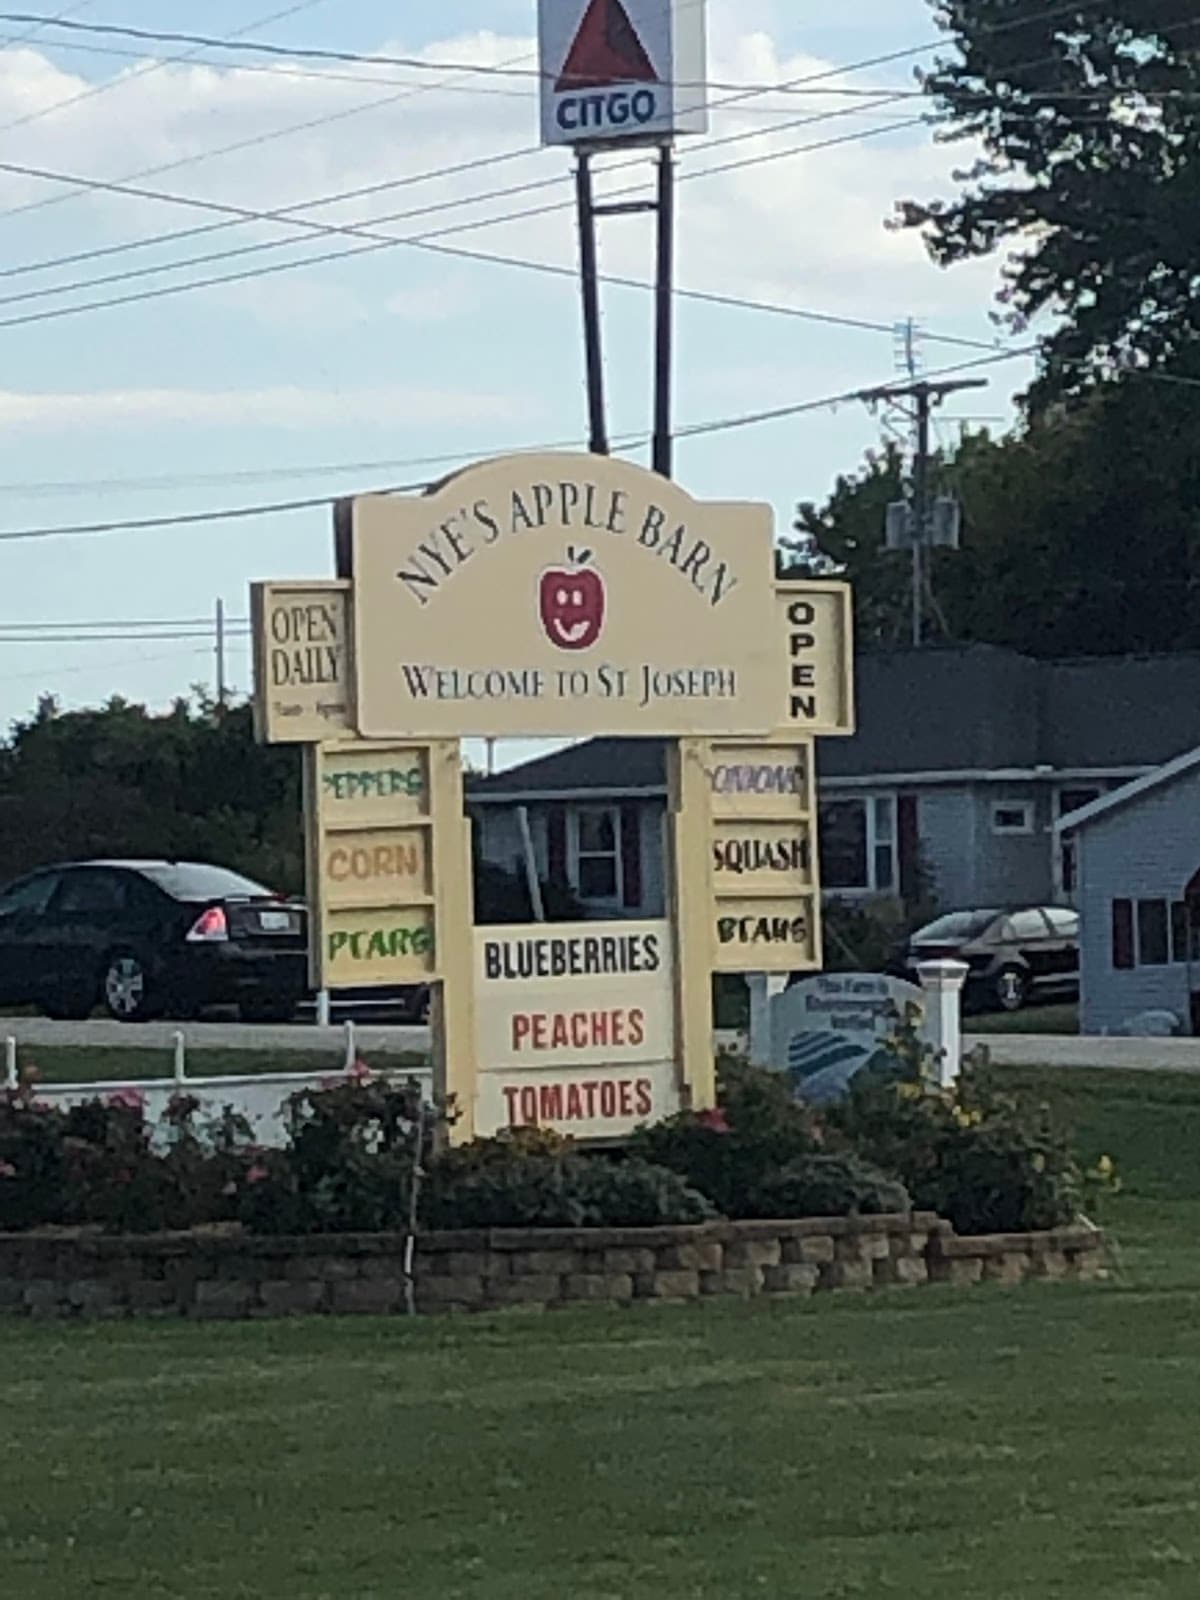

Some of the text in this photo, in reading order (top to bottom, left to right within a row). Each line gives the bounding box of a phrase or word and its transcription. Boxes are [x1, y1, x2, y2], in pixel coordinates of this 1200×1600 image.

[556, 90, 656, 130] CITGO
[396, 482, 738, 606] NYE'S APPLE BARN
[271, 604, 338, 644] OPEN
[271, 645, 345, 686] DAILY
[787, 602, 815, 719] OPEN
[638, 665, 736, 707] JOSEPH
[327, 844, 419, 882] CORN
[713, 839, 808, 874] SQUASH
[484, 933, 661, 979] BLUEBERRIES
[511, 1008, 644, 1051] PEACHES
[502, 1077, 653, 1125] TOMATOES
